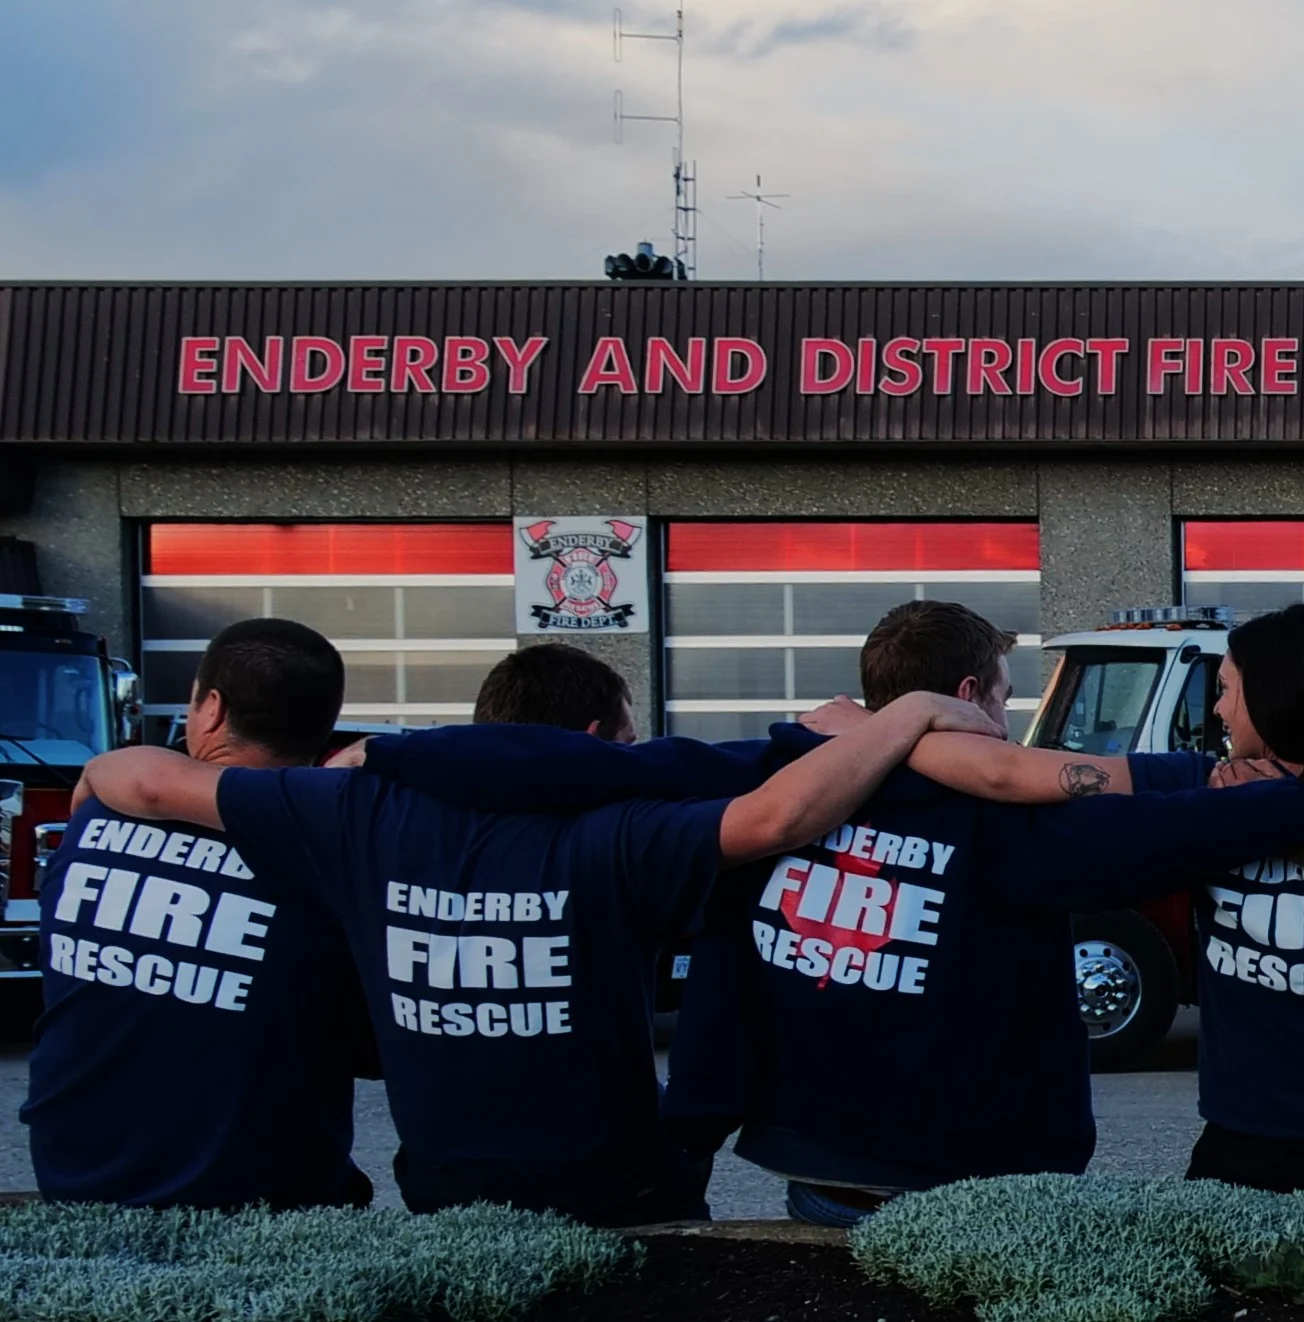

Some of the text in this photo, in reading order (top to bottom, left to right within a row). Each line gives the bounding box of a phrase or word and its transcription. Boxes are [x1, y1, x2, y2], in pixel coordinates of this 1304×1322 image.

[178, 336, 549, 395] ENDERBY
[578, 336, 768, 395] AND
[800, 337, 1129, 396] DISTRICT
[1146, 337, 1298, 396] FIRE
[550, 535, 612, 549] ENDERBY
[549, 614, 578, 627] FIRE
[78, 818, 256, 880] ENDERB
[810, 823, 956, 876] DERBY
[54, 861, 278, 962] FIRE
[386, 880, 570, 922] ENDERBY
[758, 855, 946, 946] FIRE
[50, 932, 254, 1012] RESCUE
[386, 925, 572, 990] FIRE
[752, 919, 929, 995] RESCUE
[391, 992, 573, 1038] RESCUE
